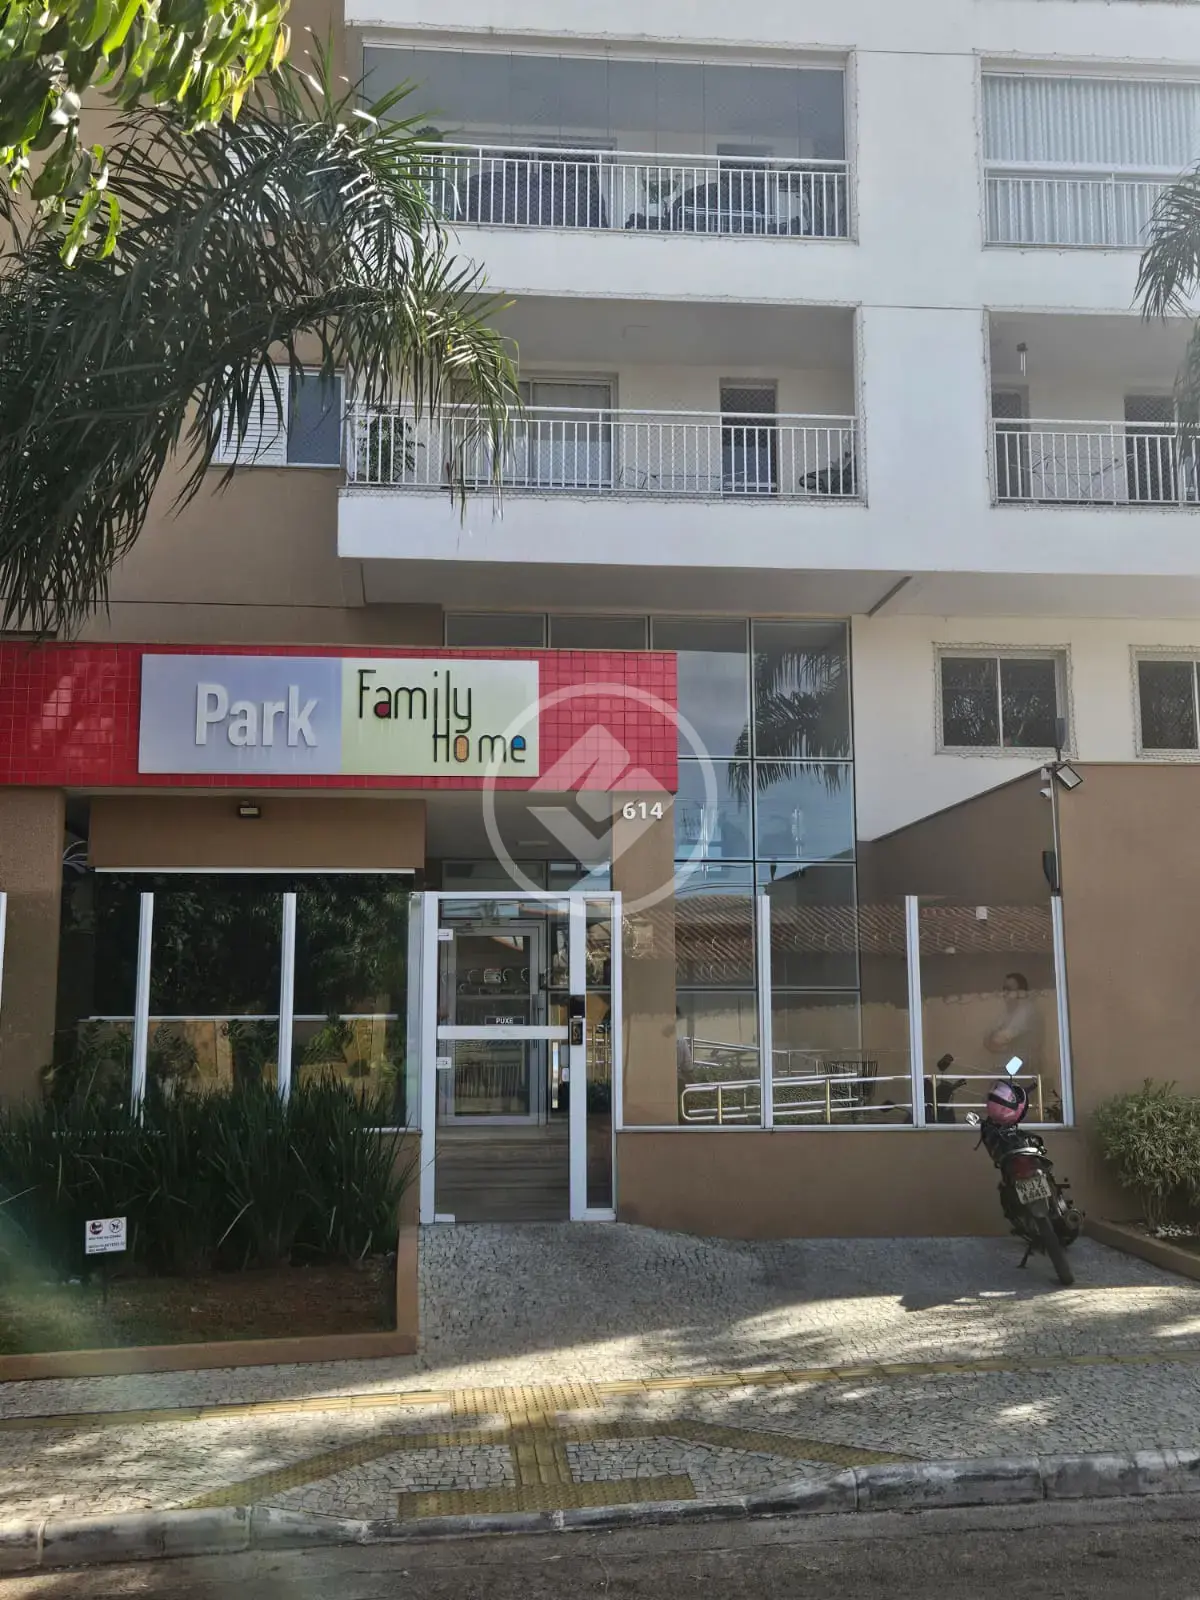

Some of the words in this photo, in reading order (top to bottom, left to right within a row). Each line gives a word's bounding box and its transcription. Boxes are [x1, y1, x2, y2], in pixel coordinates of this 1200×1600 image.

[195, 682, 319, 747] Park
[358, 669, 472, 733] Family
[432, 719, 527, 763] Home
[622, 801, 664, 820] 614
